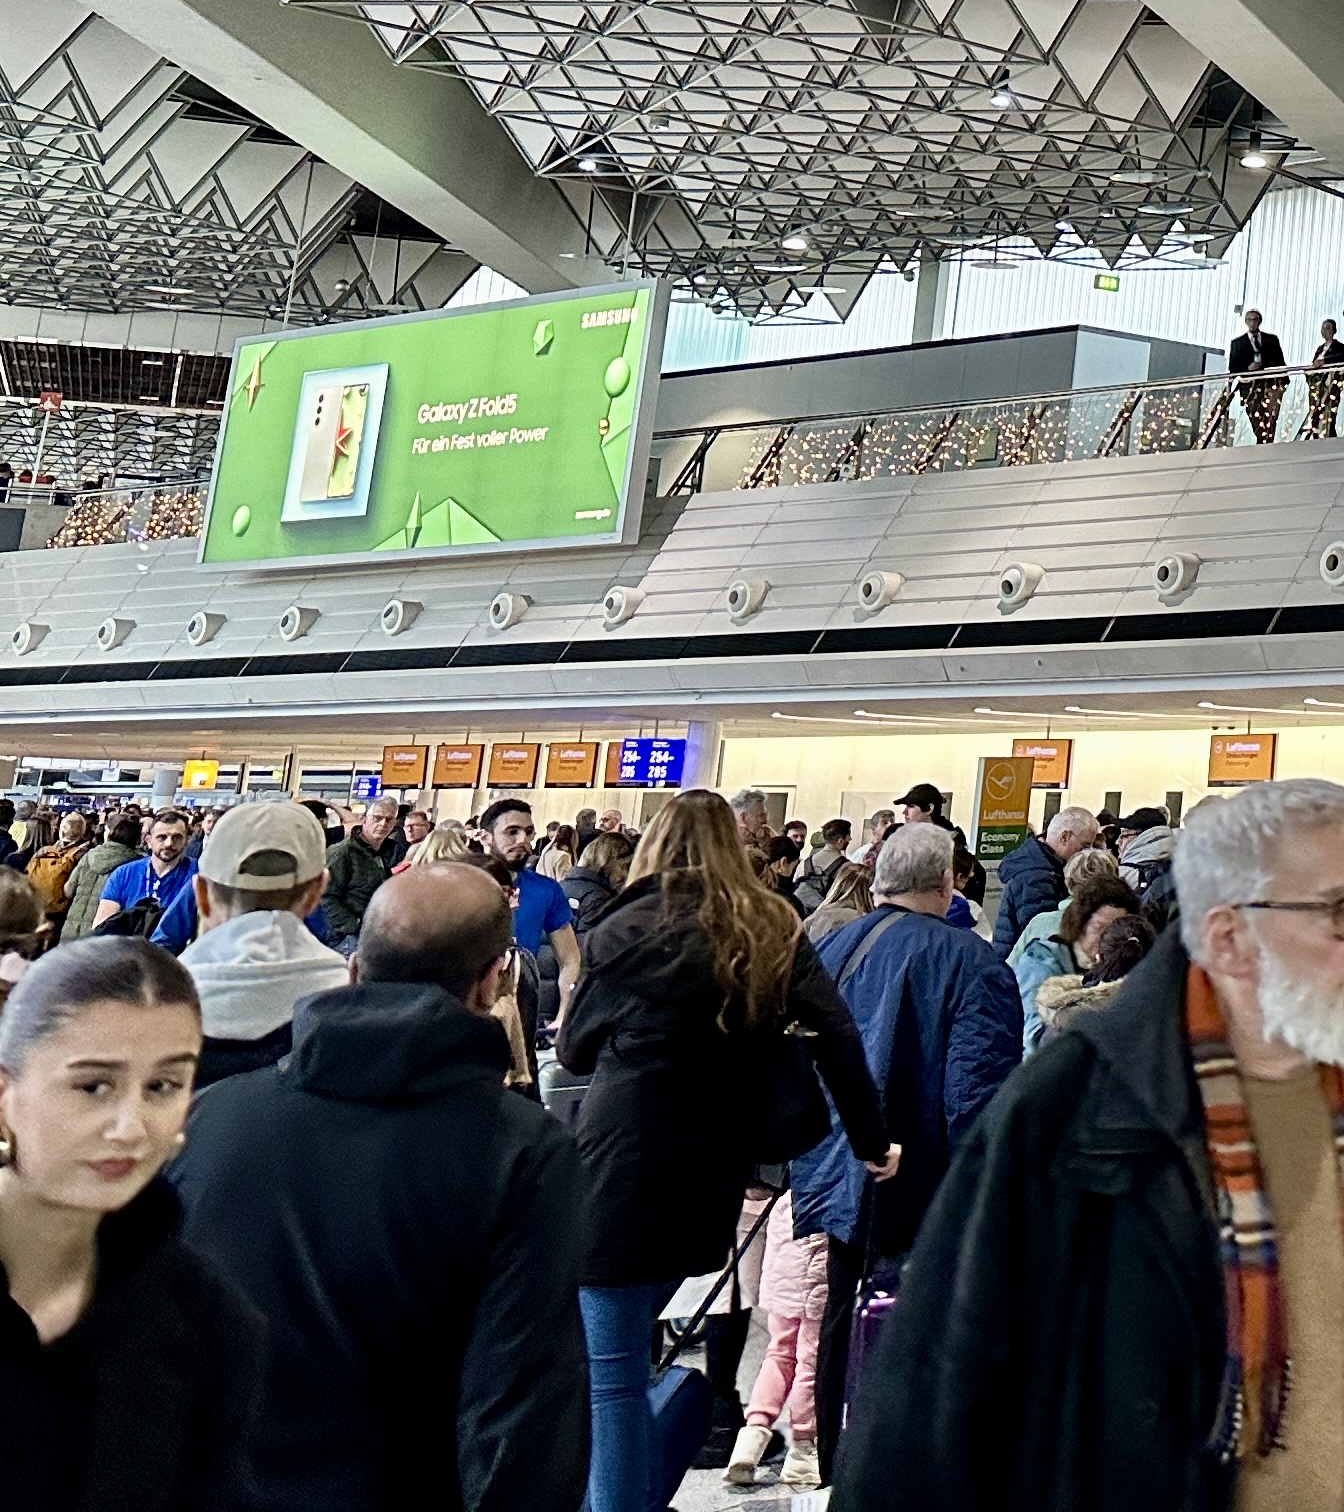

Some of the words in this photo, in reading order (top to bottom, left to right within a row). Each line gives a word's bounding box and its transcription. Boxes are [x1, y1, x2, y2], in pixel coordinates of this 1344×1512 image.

[581, 307, 639, 329] SAMSUNG
[417, 402, 469, 425] Galaxy
[467, 398, 479, 419] Z
[477, 393, 518, 418] Fold5
[411, 437, 431, 455] Für
[431, 435, 450, 453] ein
[450, 432, 476, 451] Fest
[476, 429, 509, 448] voller
[509, 426, 550, 444] Power
[983, 810, 1025, 821] Lufthansa
[981, 832, 1021, 843] Economy
[980, 844, 1004, 854] Class
